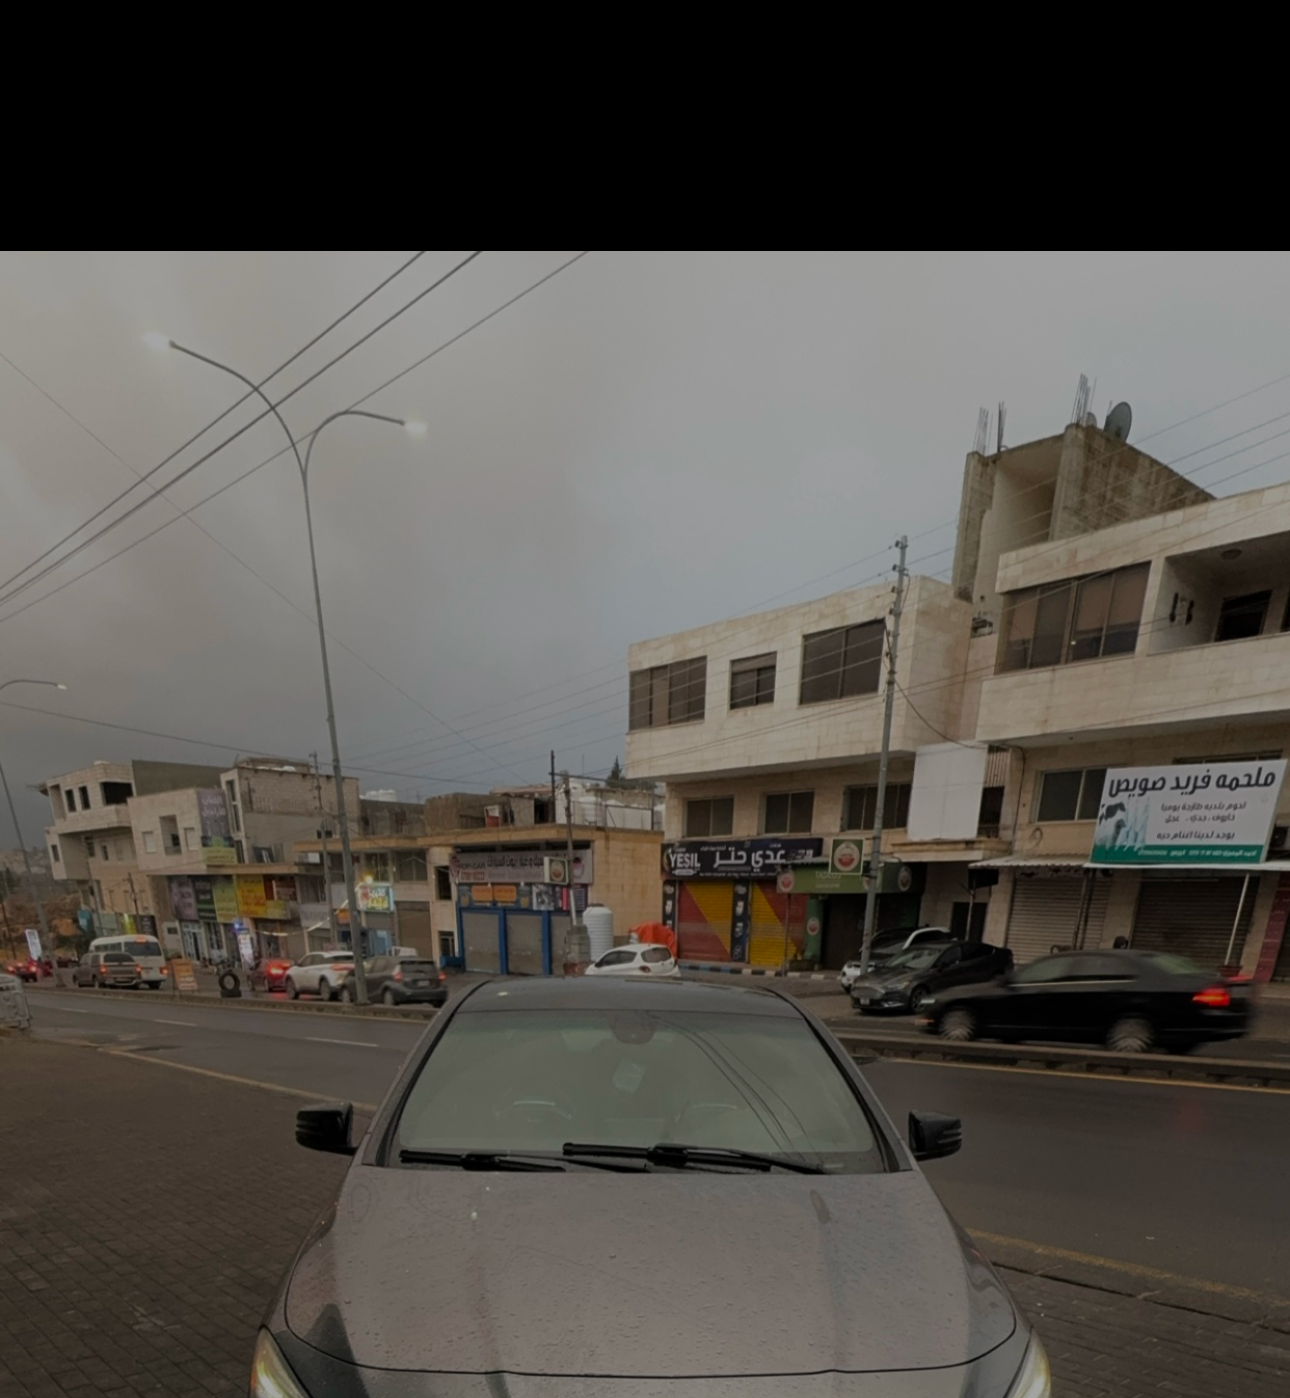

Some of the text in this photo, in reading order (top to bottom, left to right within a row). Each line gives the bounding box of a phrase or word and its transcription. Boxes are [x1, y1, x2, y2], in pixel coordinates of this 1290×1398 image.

[1108, 766, 1276, 799] ملحمه فريد صويص
[1226, 801, 1247, 811] لحوم
[1215, 831, 1235, 841] يوجد
[713, 847, 747, 869] حتر
[751, 849, 786, 873] عدي
